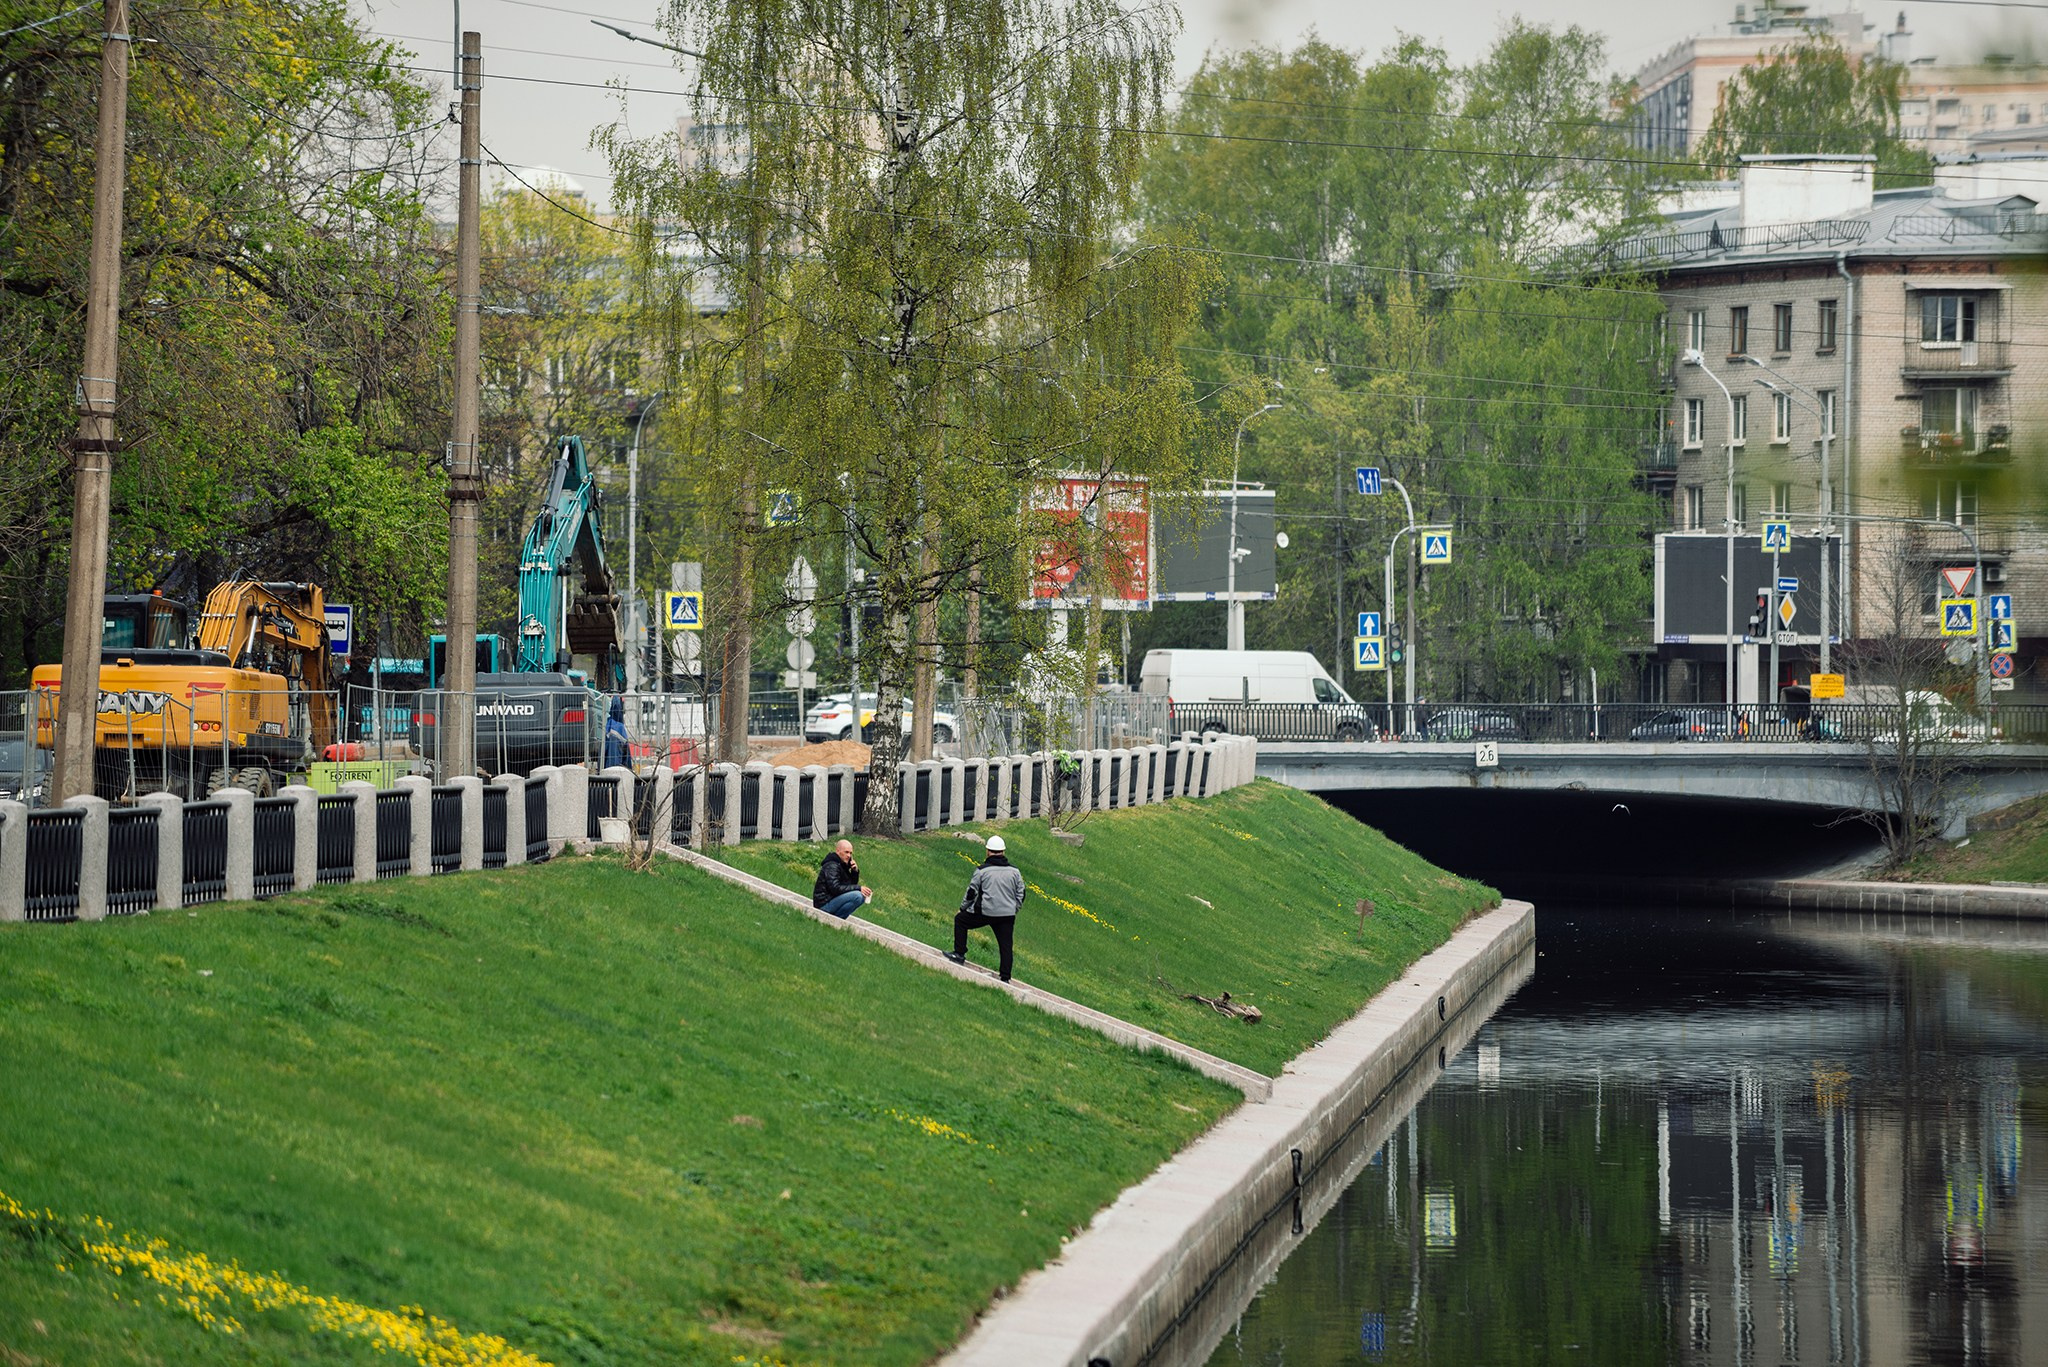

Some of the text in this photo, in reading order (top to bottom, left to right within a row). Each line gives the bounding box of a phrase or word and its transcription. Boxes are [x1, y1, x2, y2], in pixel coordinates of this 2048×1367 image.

[1777, 633, 1795, 643] СТОП
[1479, 749, 1495, 762] 2.6
[330, 770, 373, 782] FORTRENT
